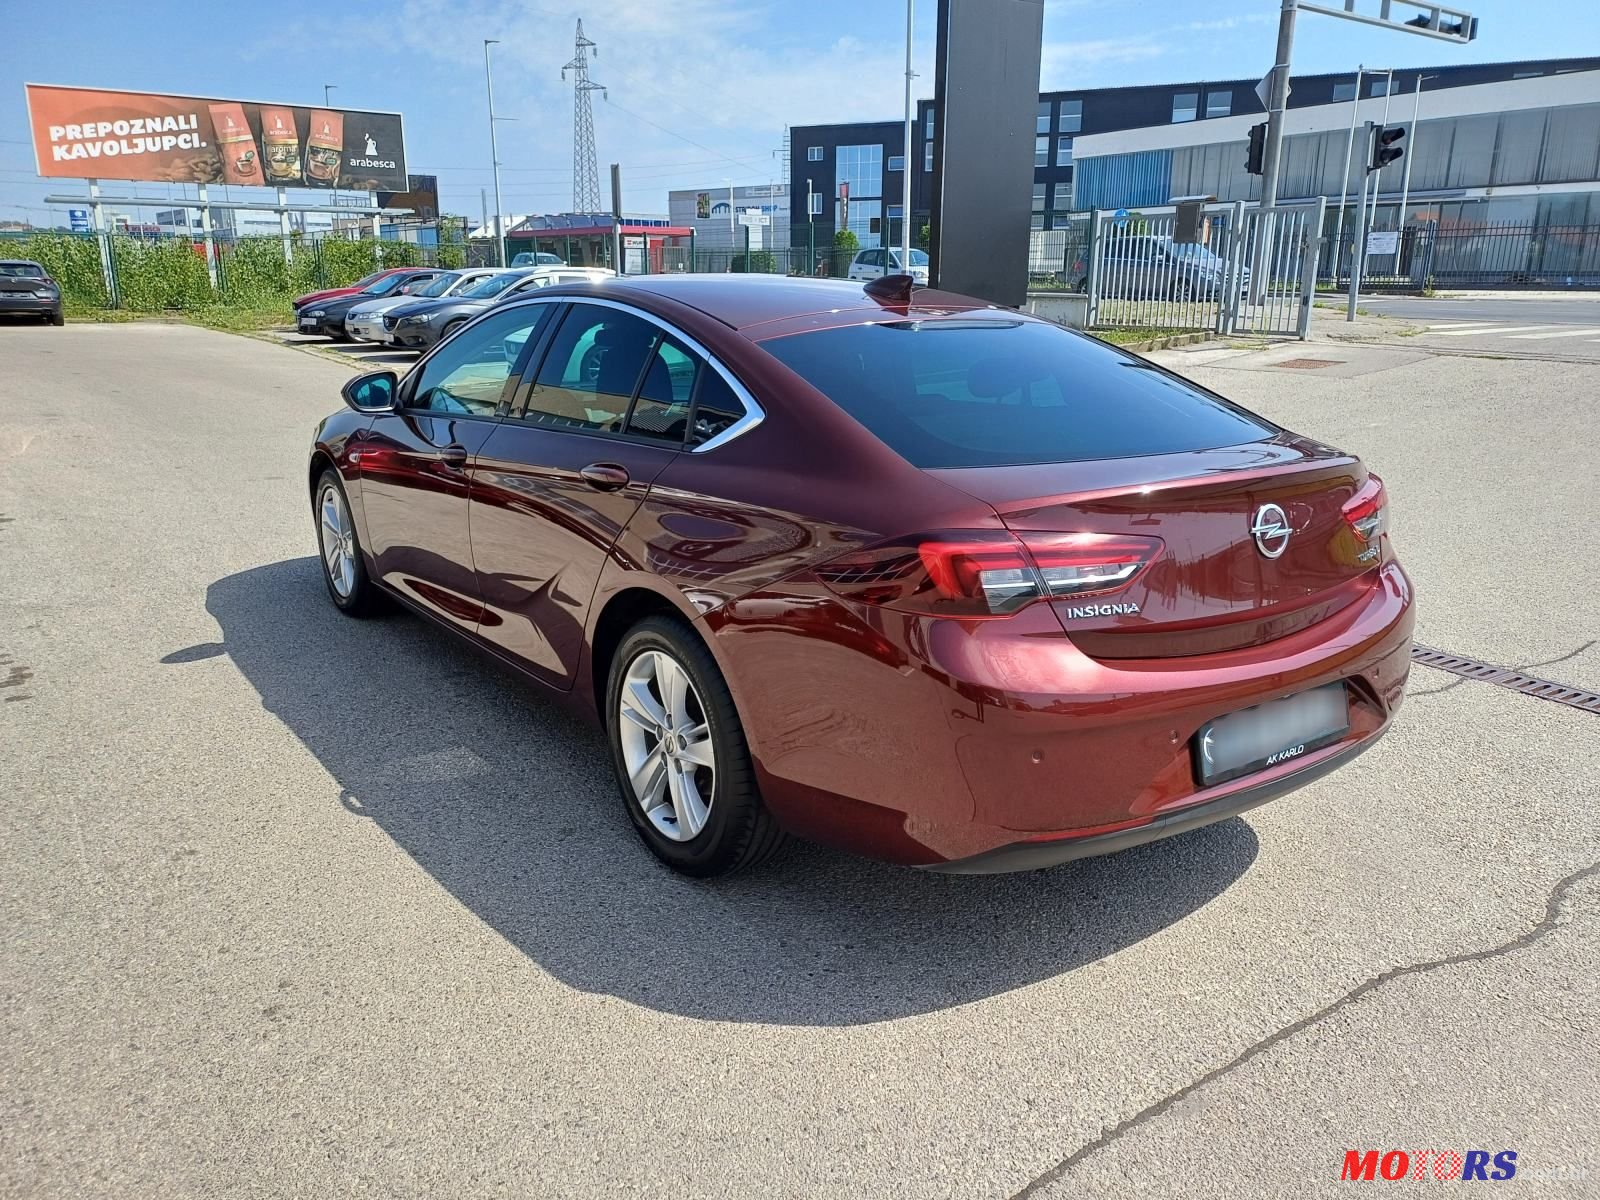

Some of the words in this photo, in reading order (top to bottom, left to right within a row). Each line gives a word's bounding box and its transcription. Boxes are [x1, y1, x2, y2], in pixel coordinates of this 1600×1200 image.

[48, 114, 198, 142] PREPOZNALI
[52, 133, 207, 161] KAVOLJUPCI.
[350, 158, 396, 169] arabesca
[1067, 603, 1140, 619] INSIGNIA
[1266, 754, 1279, 765] AK
[1279, 745, 1304, 761] KARLO
